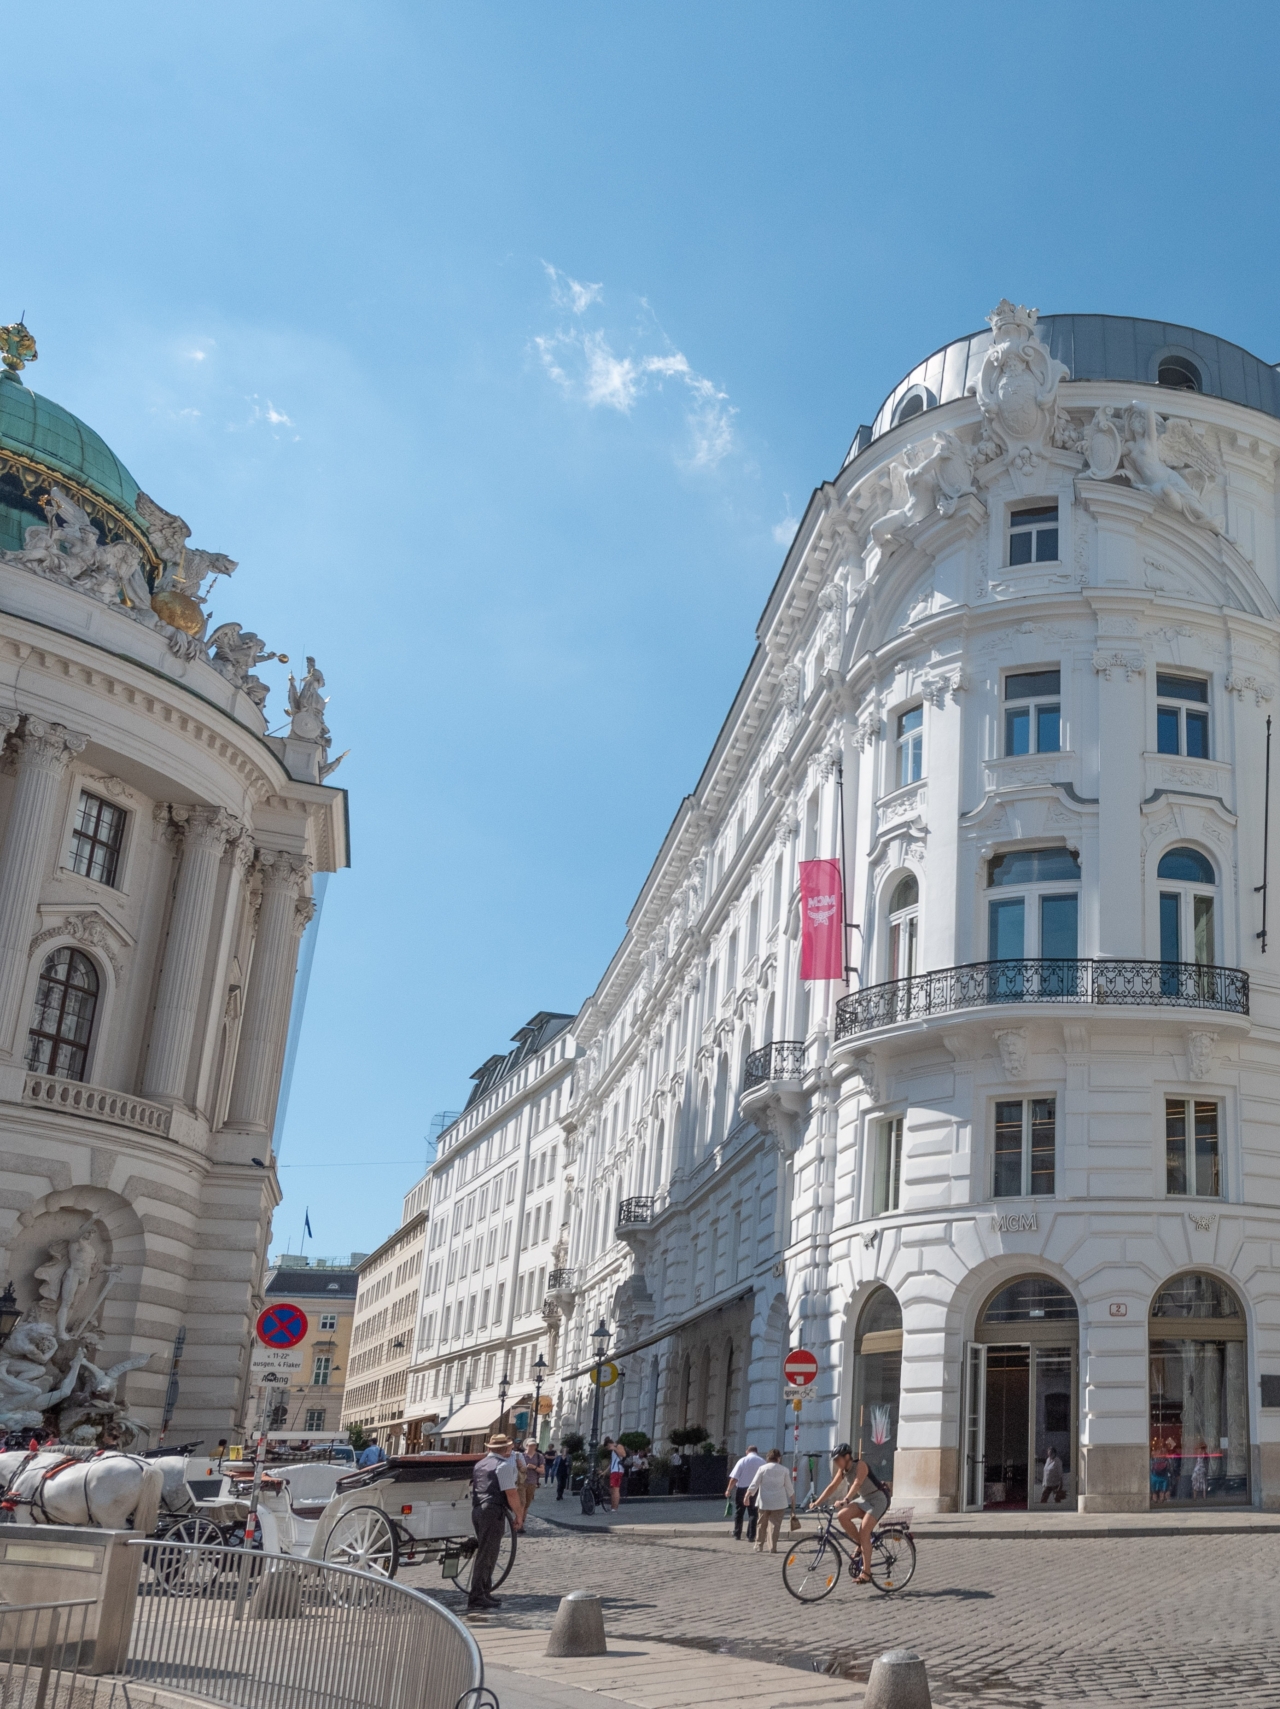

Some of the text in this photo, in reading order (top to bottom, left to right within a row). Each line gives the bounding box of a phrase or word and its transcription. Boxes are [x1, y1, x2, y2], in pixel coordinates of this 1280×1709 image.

[991, 1212, 1037, 1231] MCM
[1115, 1304, 1121, 1313] 2
[261, 1374, 289, 1385] Aang
